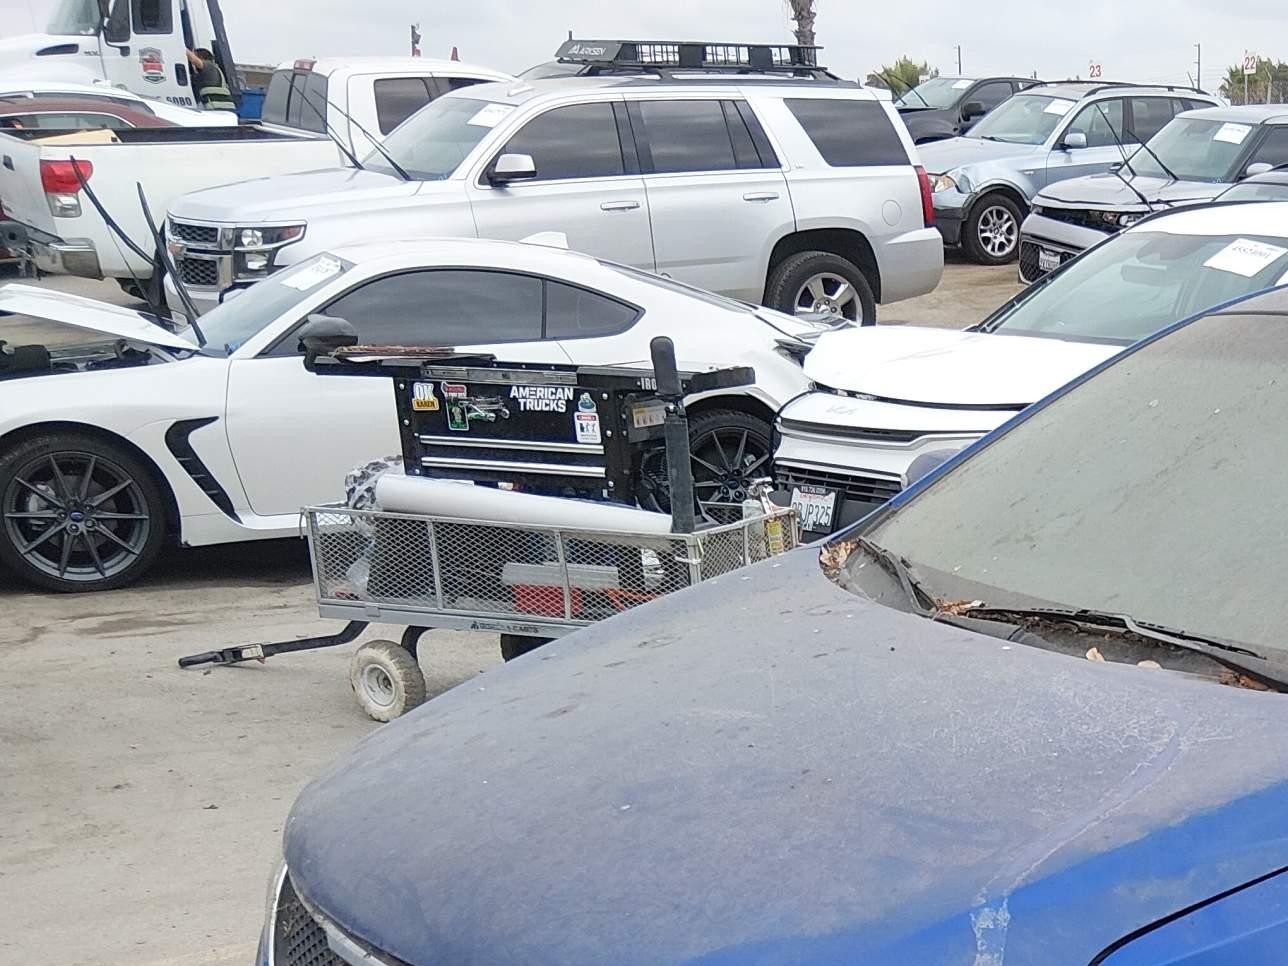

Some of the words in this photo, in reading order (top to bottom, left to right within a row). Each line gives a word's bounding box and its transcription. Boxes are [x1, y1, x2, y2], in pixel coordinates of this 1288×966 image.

[1244, 56, 1256, 70] 22
[1089, 64, 1102, 78] 23
[509, 385, 574, 400] AMERICAN
[518, 398, 567, 413] TRUCKS
